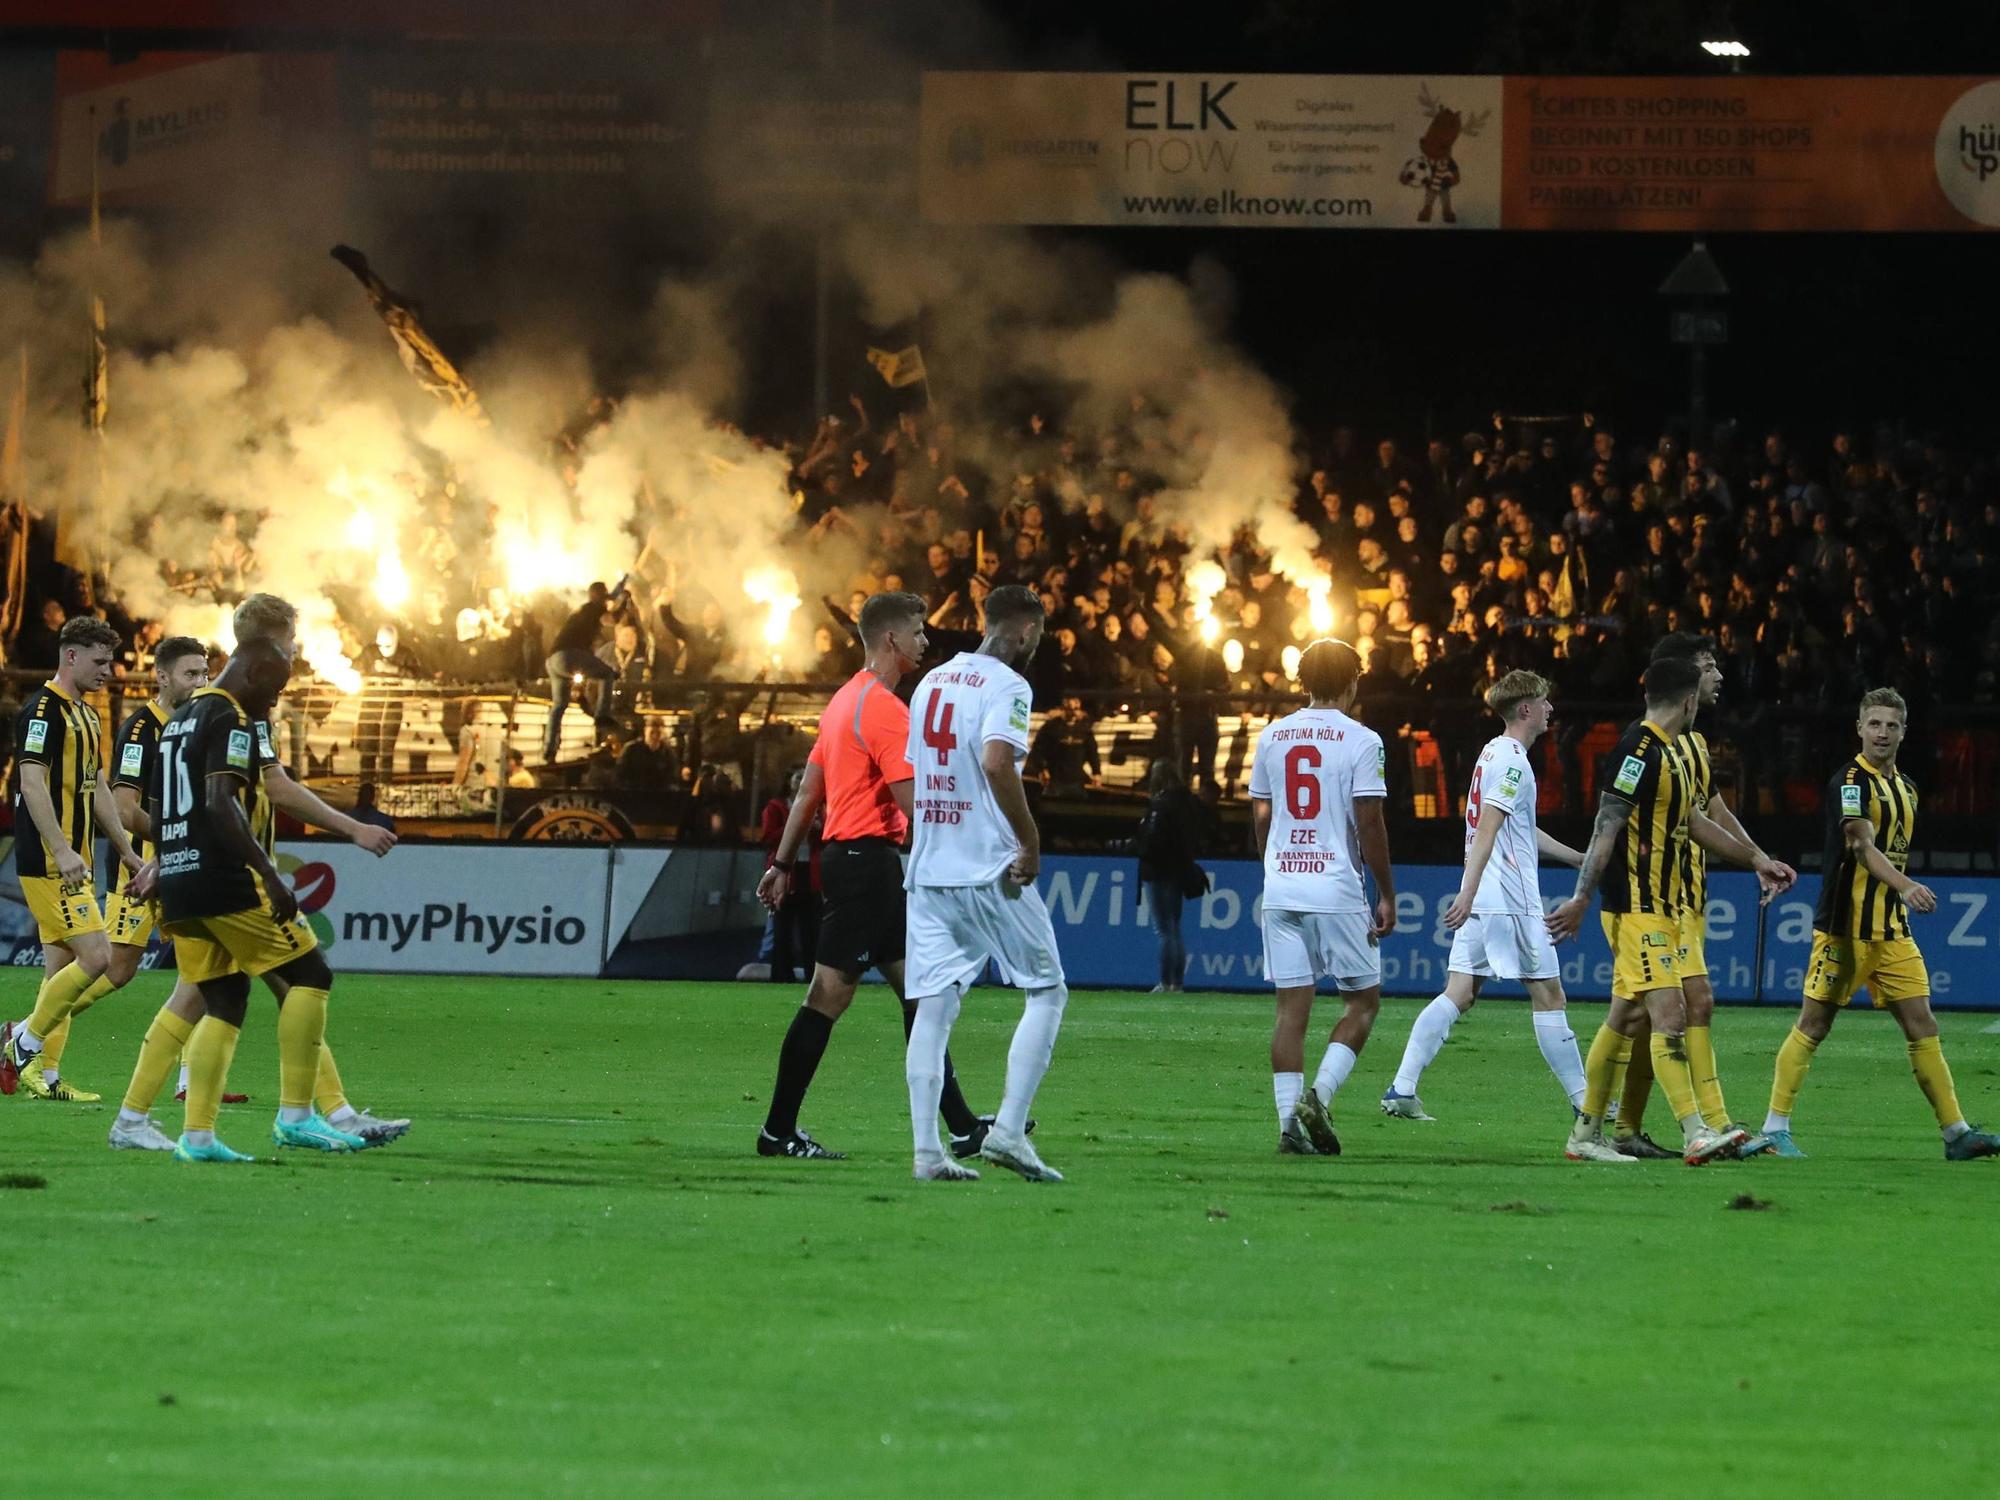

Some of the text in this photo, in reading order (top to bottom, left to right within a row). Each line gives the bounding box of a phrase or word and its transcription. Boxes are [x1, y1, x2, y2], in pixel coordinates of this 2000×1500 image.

[1126, 81, 1238, 130] ELK
[1296, 98, 1353, 114] Digitales
[1530, 97, 1747, 115] ECHTES SHOPPING
[1530, 127, 1812, 146] BEGINNT MIT 150 SHOPS
[1124, 137, 1239, 173] now
[1290, 141, 1380, 153] Unternehmen
[1530, 157, 1756, 177] UND KOSTENLOSEN
[1123, 190, 1373, 216] www.elknow.com
[923, 688, 957, 766] 4
[1272, 728, 1313, 742] FORTUNA
[159, 736, 193, 820] 16
[1285, 745, 1322, 820] 6
[1290, 829, 1317, 845] EZE
[1278, 860, 1326, 874] AUDIO
[343, 902, 586, 955] myPhysio
